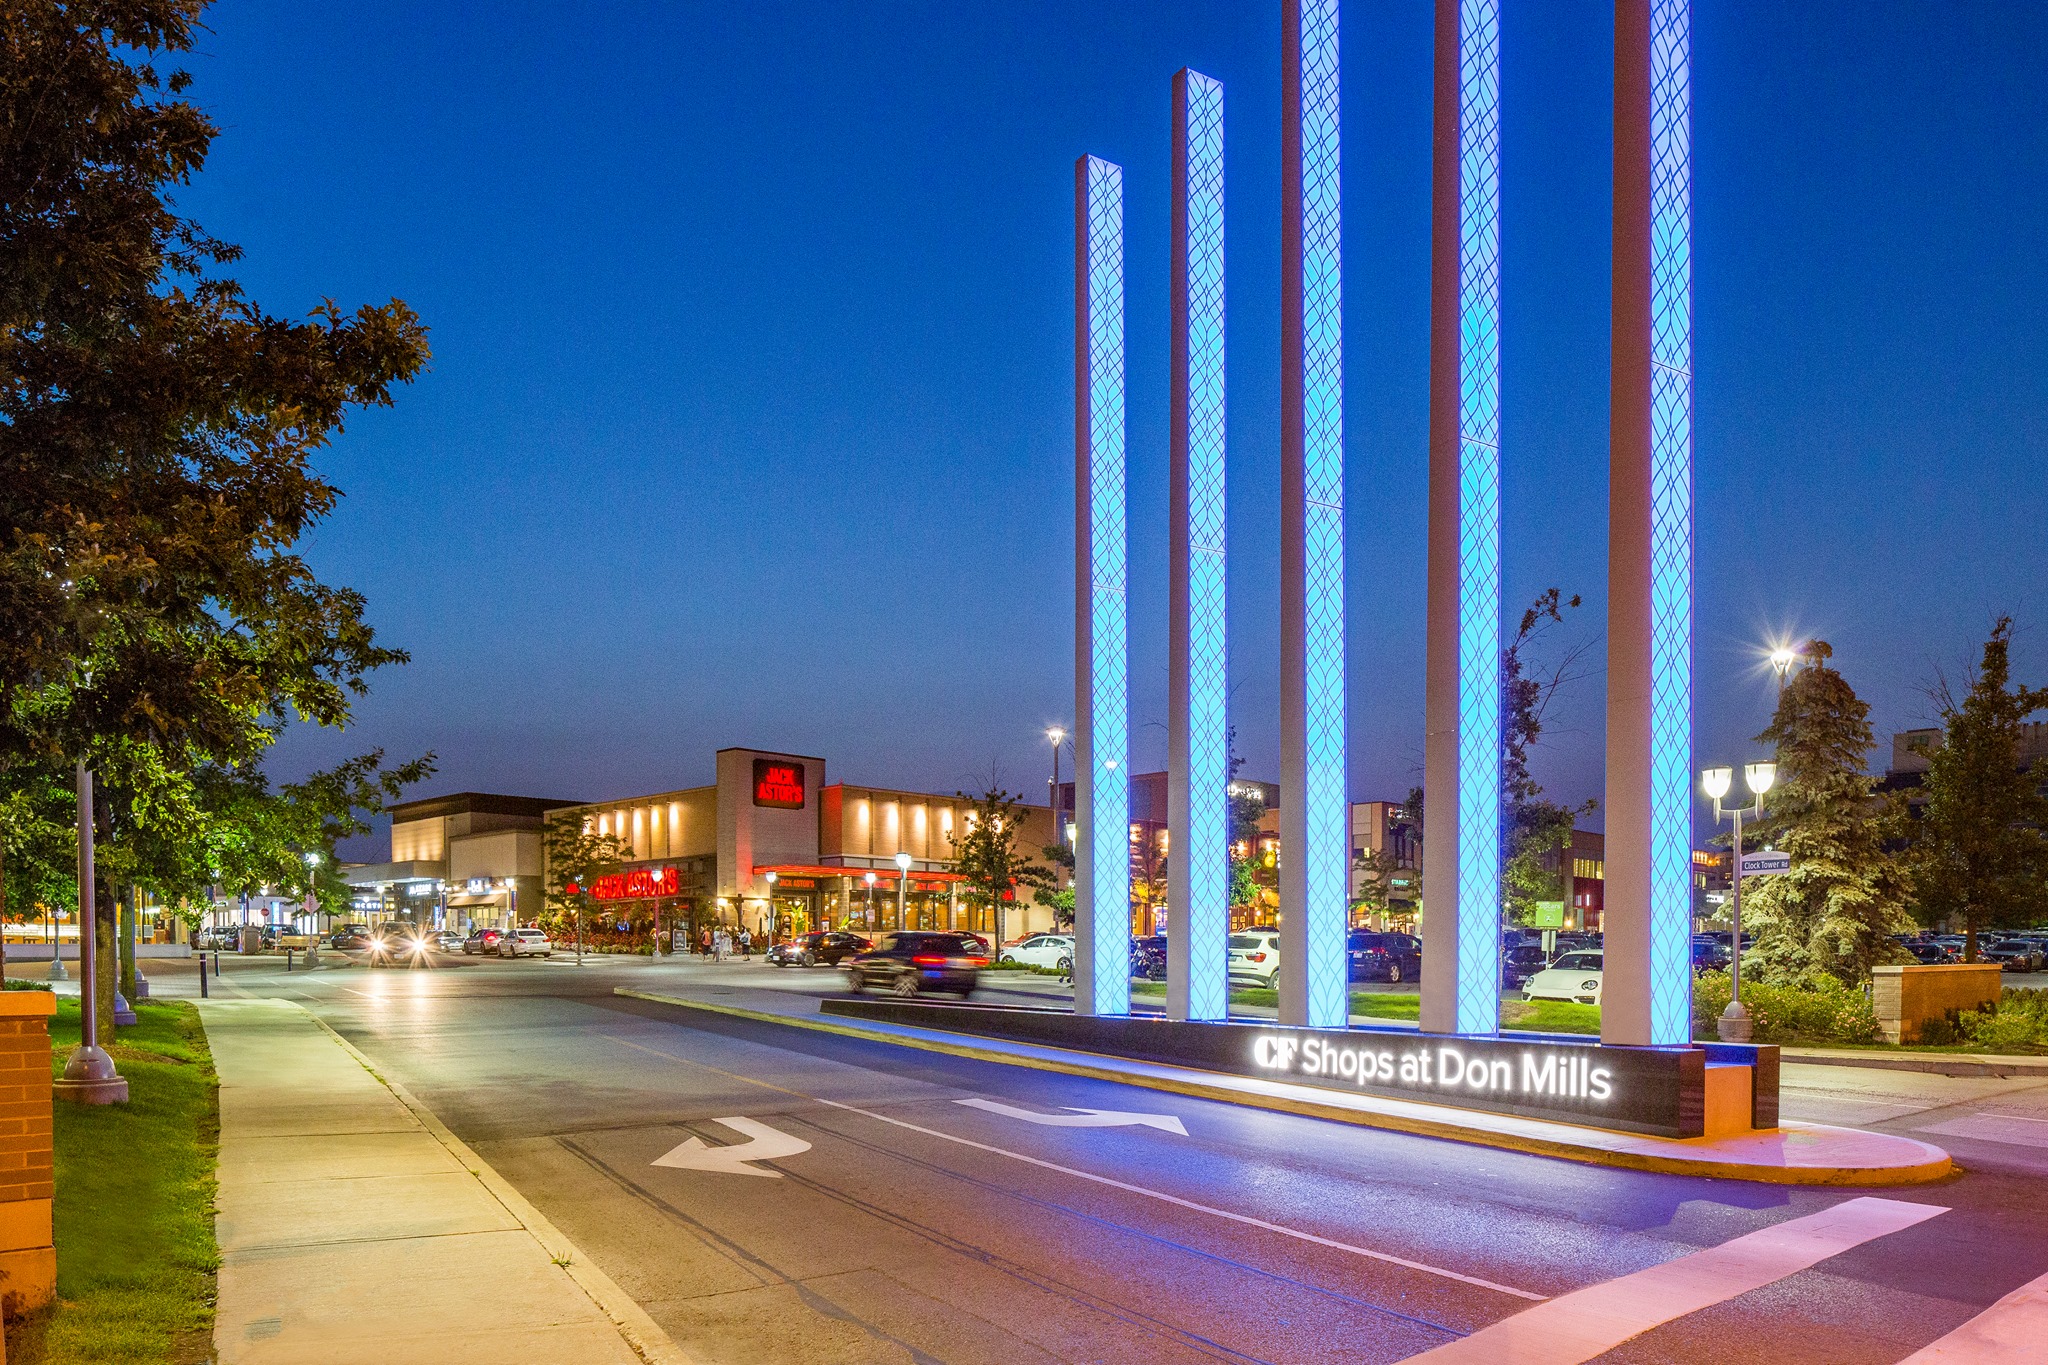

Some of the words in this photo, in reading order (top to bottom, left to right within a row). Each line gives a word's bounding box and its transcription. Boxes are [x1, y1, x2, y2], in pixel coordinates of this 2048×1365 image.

[766, 767, 794, 785] JACK
[758, 783, 803, 803] ASTOR'S
[593, 874, 624, 898] JACK
[779, 879, 792, 887] JACK
[1254, 1036, 1298, 1068] CF
[1302, 1039, 1394, 1085] Shops
[1400, 1049, 1431, 1083] at
[1439, 1048, 1511, 1090] Don
[1523, 1053, 1612, 1099] Mills
